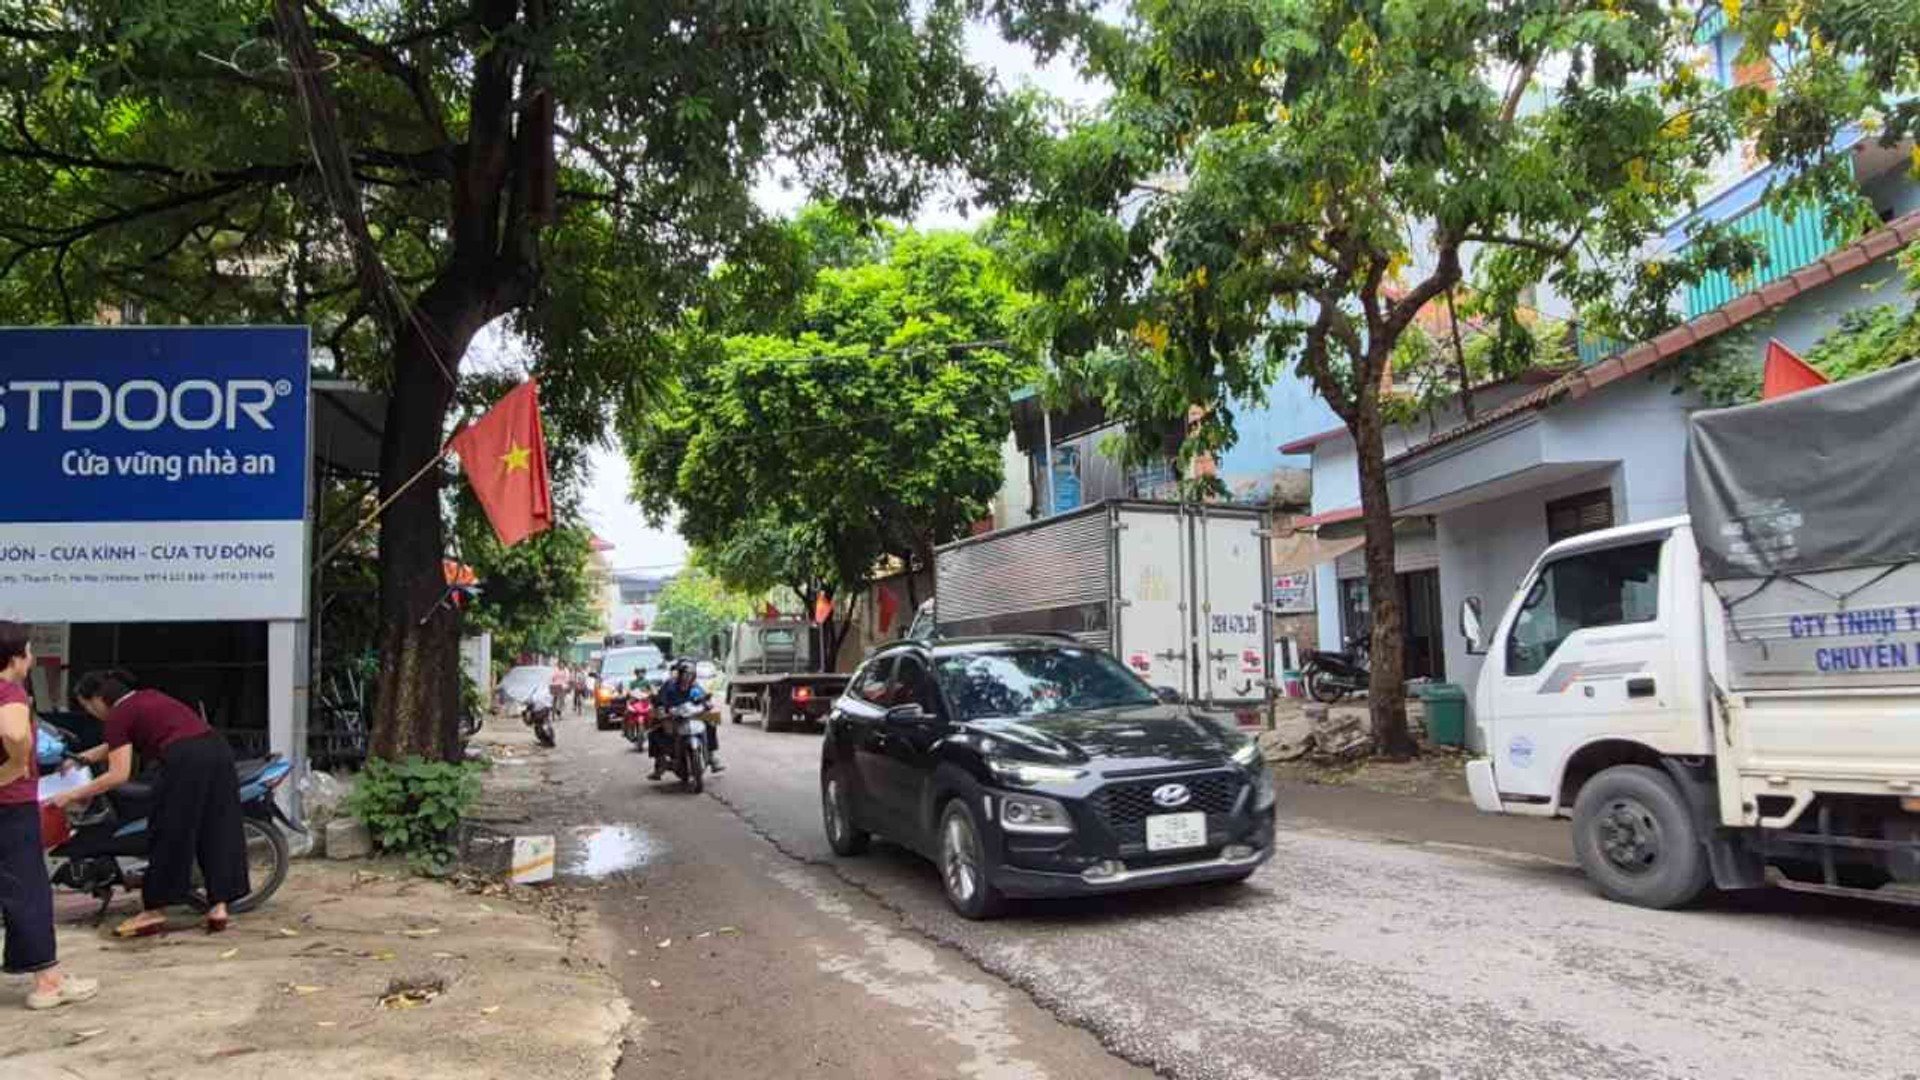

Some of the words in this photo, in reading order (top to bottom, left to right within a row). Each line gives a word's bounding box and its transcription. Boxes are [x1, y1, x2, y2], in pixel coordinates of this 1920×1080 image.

[61, 448, 110, 476] Cửa
[114, 450, 182, 481] vững
[187, 448, 238, 475] nhà
[242, 454, 276, 474] an
[1790, 614, 1826, 638] CTY
[1835, 608, 1896, 636] TNHH
